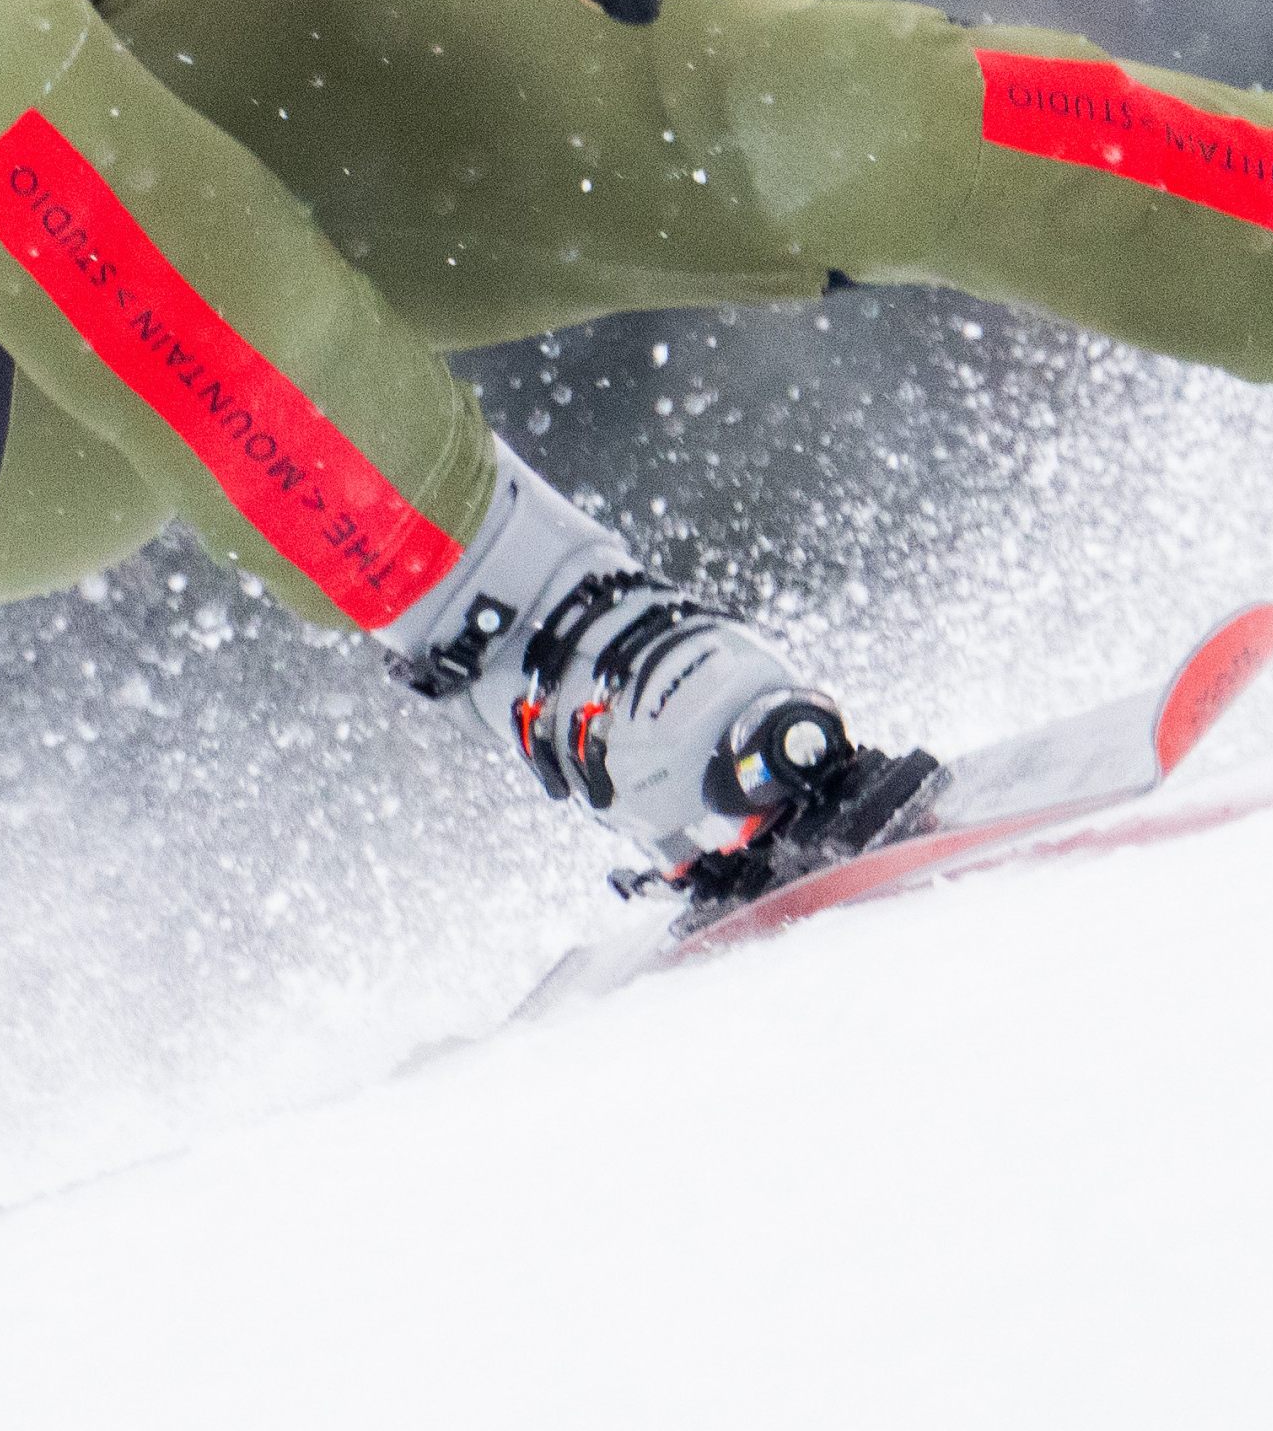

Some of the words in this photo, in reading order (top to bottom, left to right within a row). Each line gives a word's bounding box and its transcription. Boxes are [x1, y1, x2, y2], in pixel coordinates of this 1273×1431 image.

[10, 166, 117, 288] STUDIO
[130, 310, 307, 493] MOUNTAIN
[323, 511, 396, 590] THE
